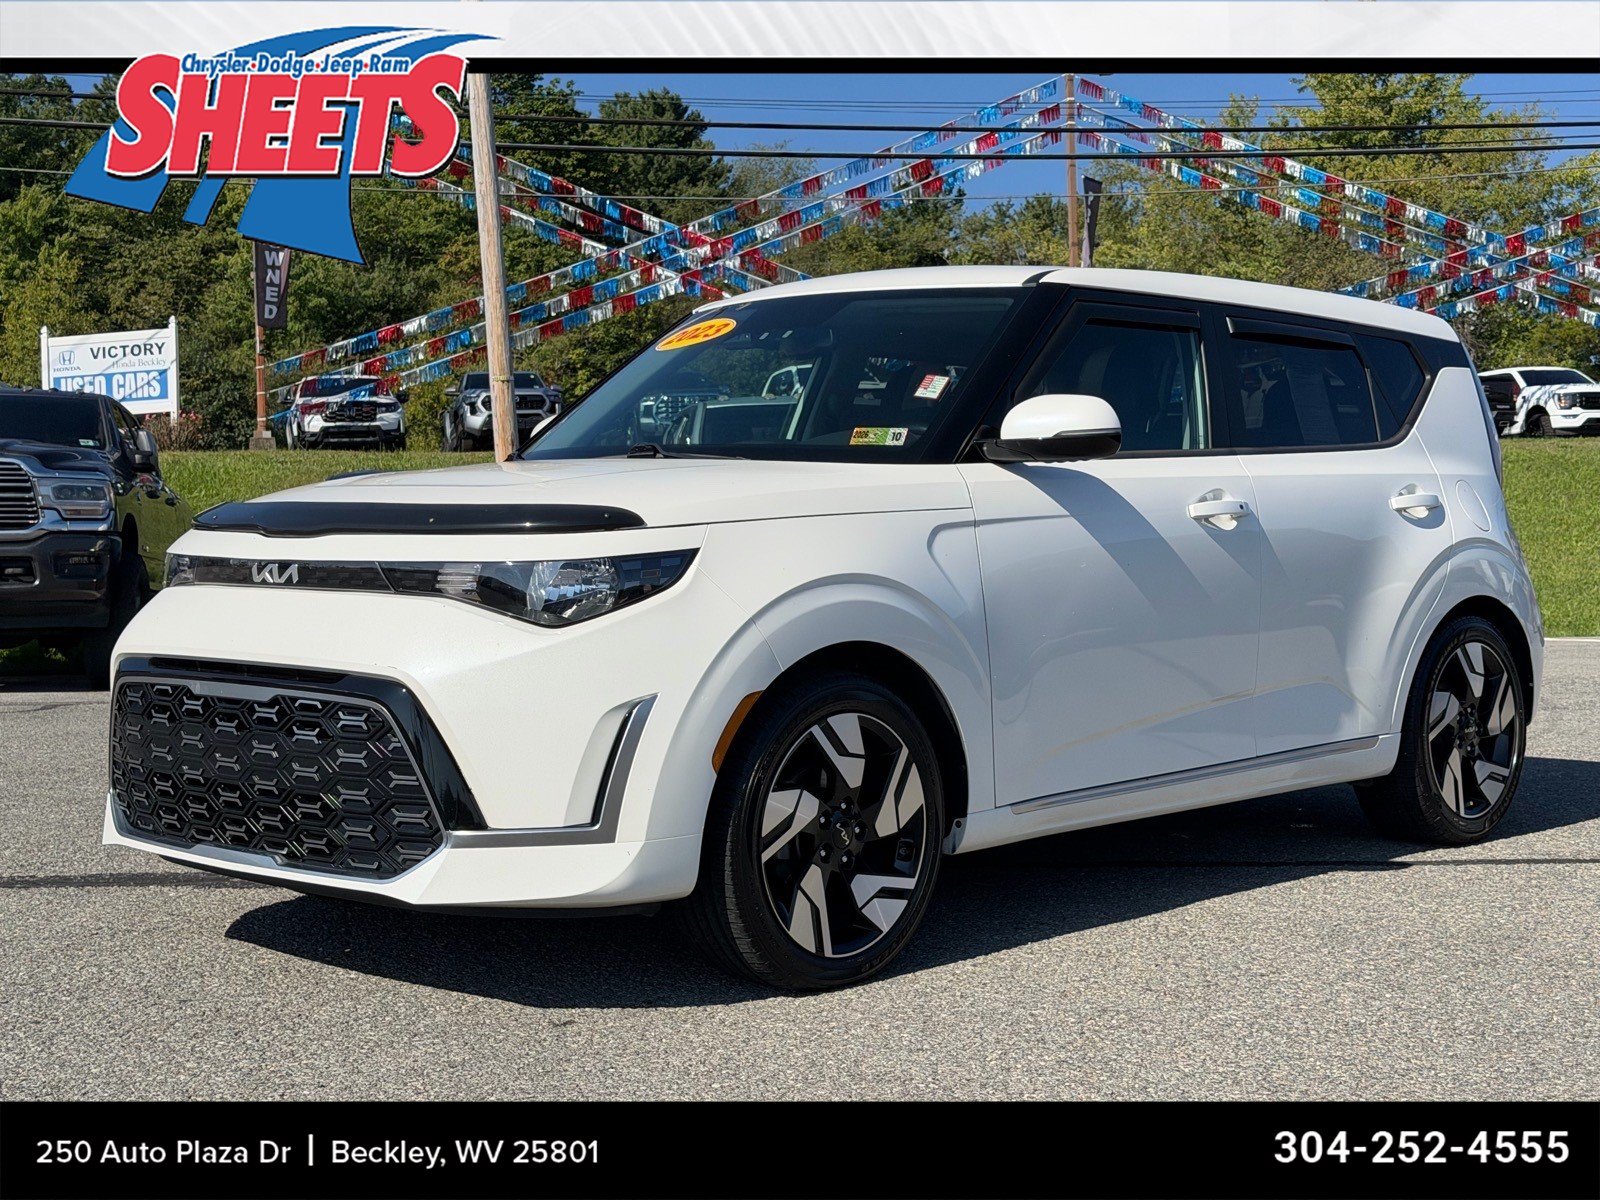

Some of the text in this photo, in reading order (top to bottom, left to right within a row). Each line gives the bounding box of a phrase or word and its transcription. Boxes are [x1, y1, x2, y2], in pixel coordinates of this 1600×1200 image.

[264, 244, 284, 319] WNED
[659, 323, 730, 347] 2023
[90, 342, 166, 359] VICTORY
[111, 358, 167, 369] Honda Beckley
[112, 371, 161, 400] CARS
[891, 432, 902, 441] 10
[252, 563, 299, 584] KIA
